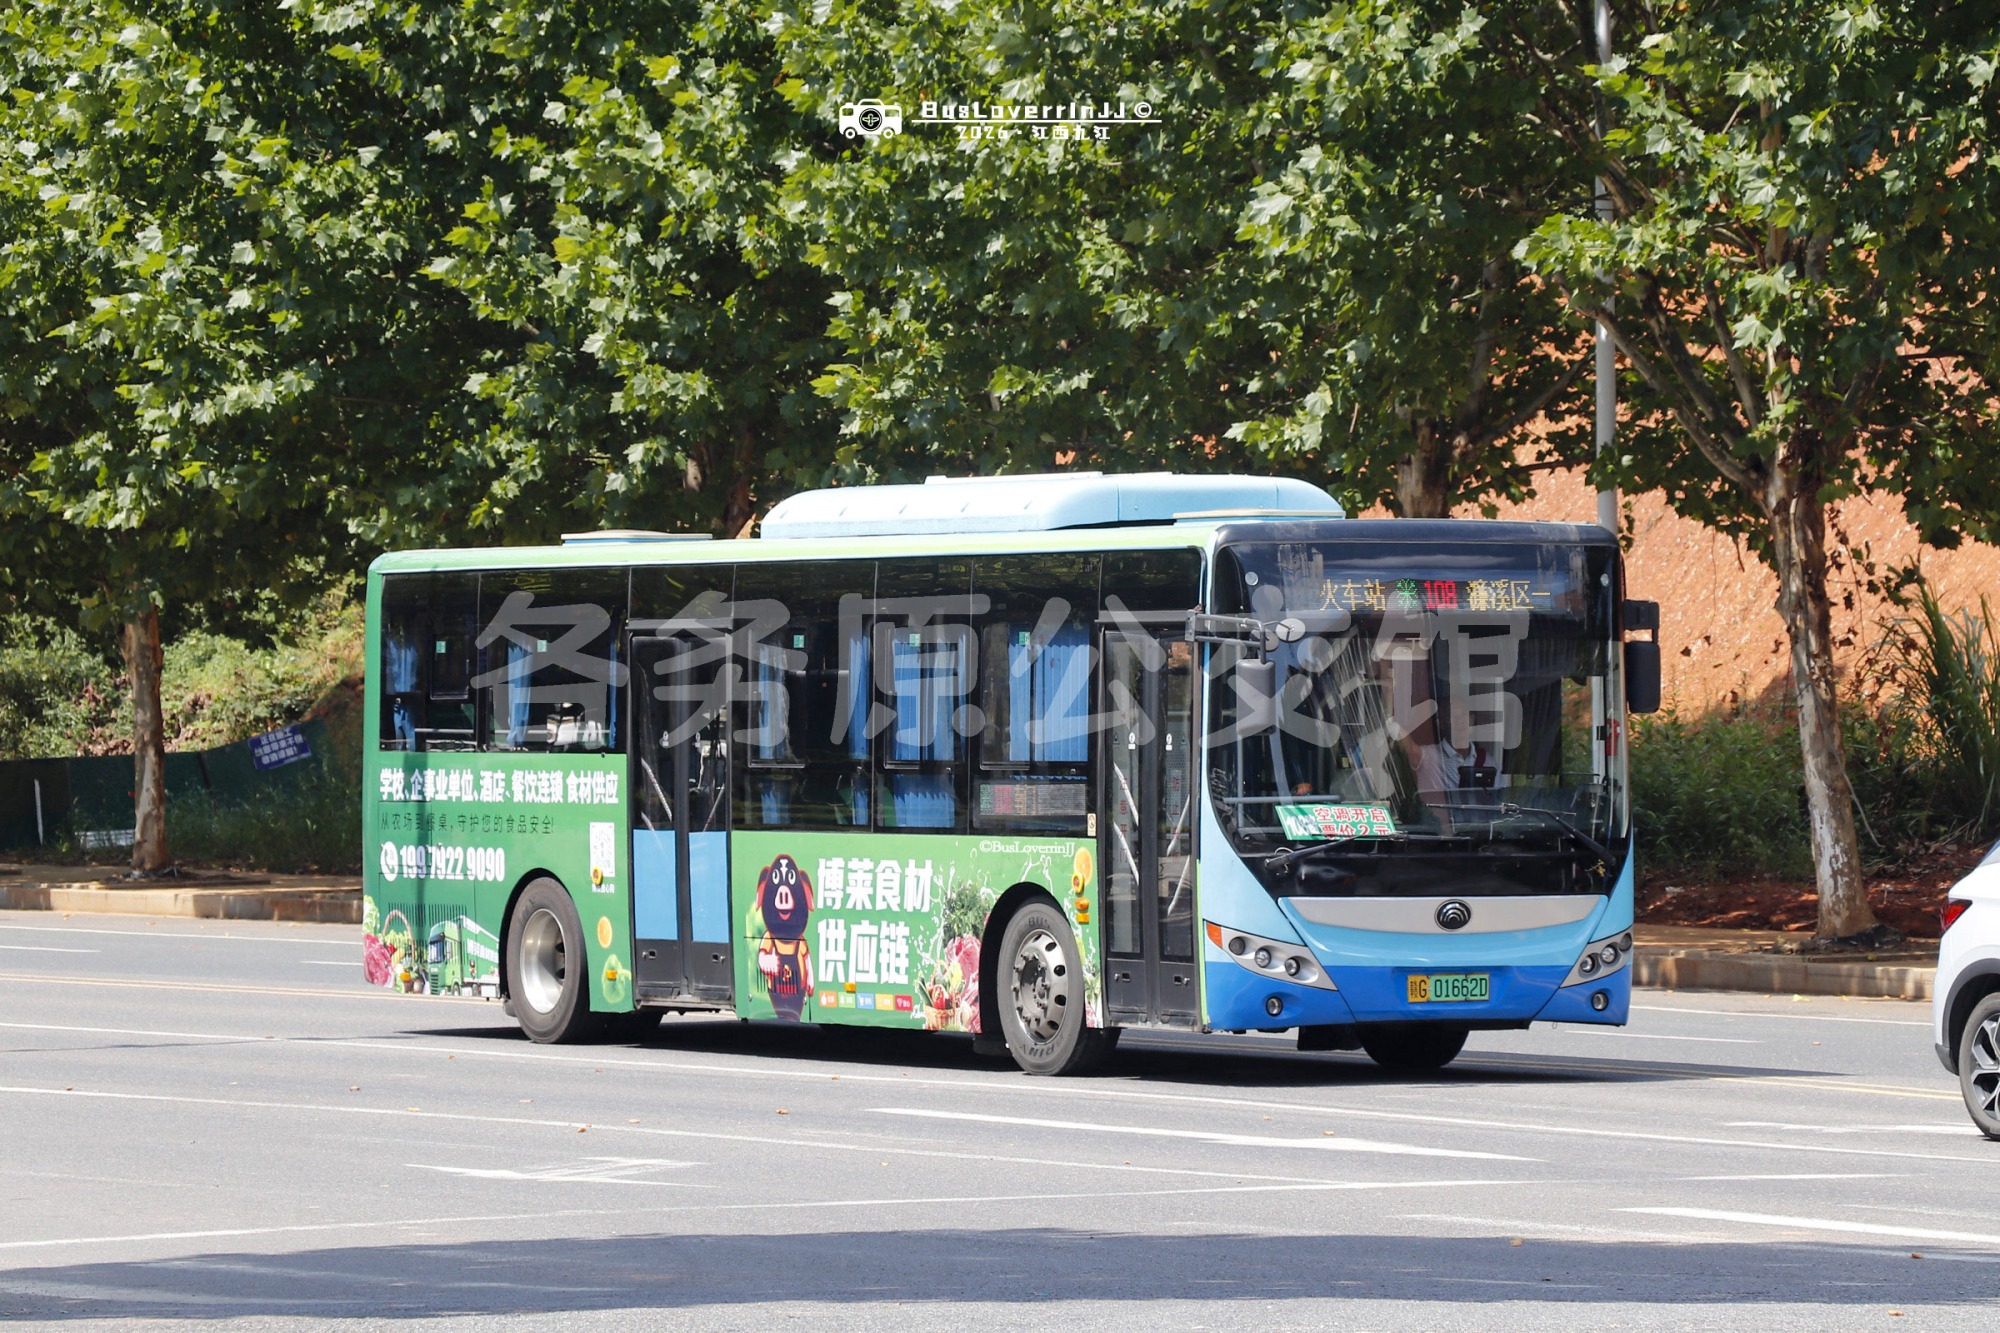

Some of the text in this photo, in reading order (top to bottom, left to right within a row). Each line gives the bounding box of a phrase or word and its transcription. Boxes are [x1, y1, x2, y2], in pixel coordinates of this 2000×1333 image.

[1320, 578, 1386, 611] 火车站
[1424, 580, 1458, 609] 108
[566, 769, 619, 805] 食材供应
[1314, 807, 1387, 822] 空调开启
[400, 843, 505, 882] 199 7922 9090
[817, 857, 932, 912] 博莱食材
[817, 918, 910, 985] 供应链
[1434, 977, 1488, 998] 01662D
